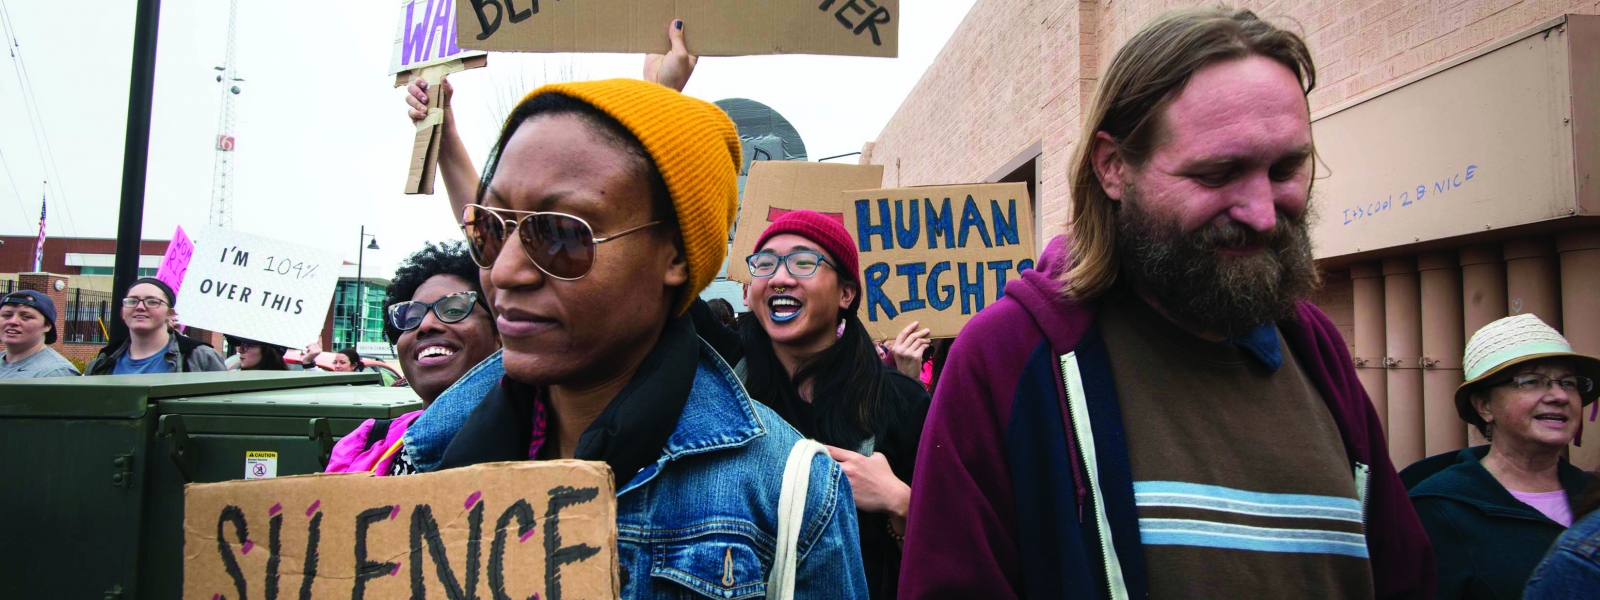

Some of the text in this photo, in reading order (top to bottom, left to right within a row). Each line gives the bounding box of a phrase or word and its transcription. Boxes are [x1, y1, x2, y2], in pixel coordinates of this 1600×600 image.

[221, 136, 233, 150] 6
[1399, 191, 1413, 207] 2
[1416, 184, 1427, 200] B
[1433, 164, 1479, 196] NICE
[855, 194, 1020, 252] HUMAN
[220, 246, 320, 279] I'M 104%
[199, 278, 252, 303] OVER
[261, 291, 304, 315] THIS
